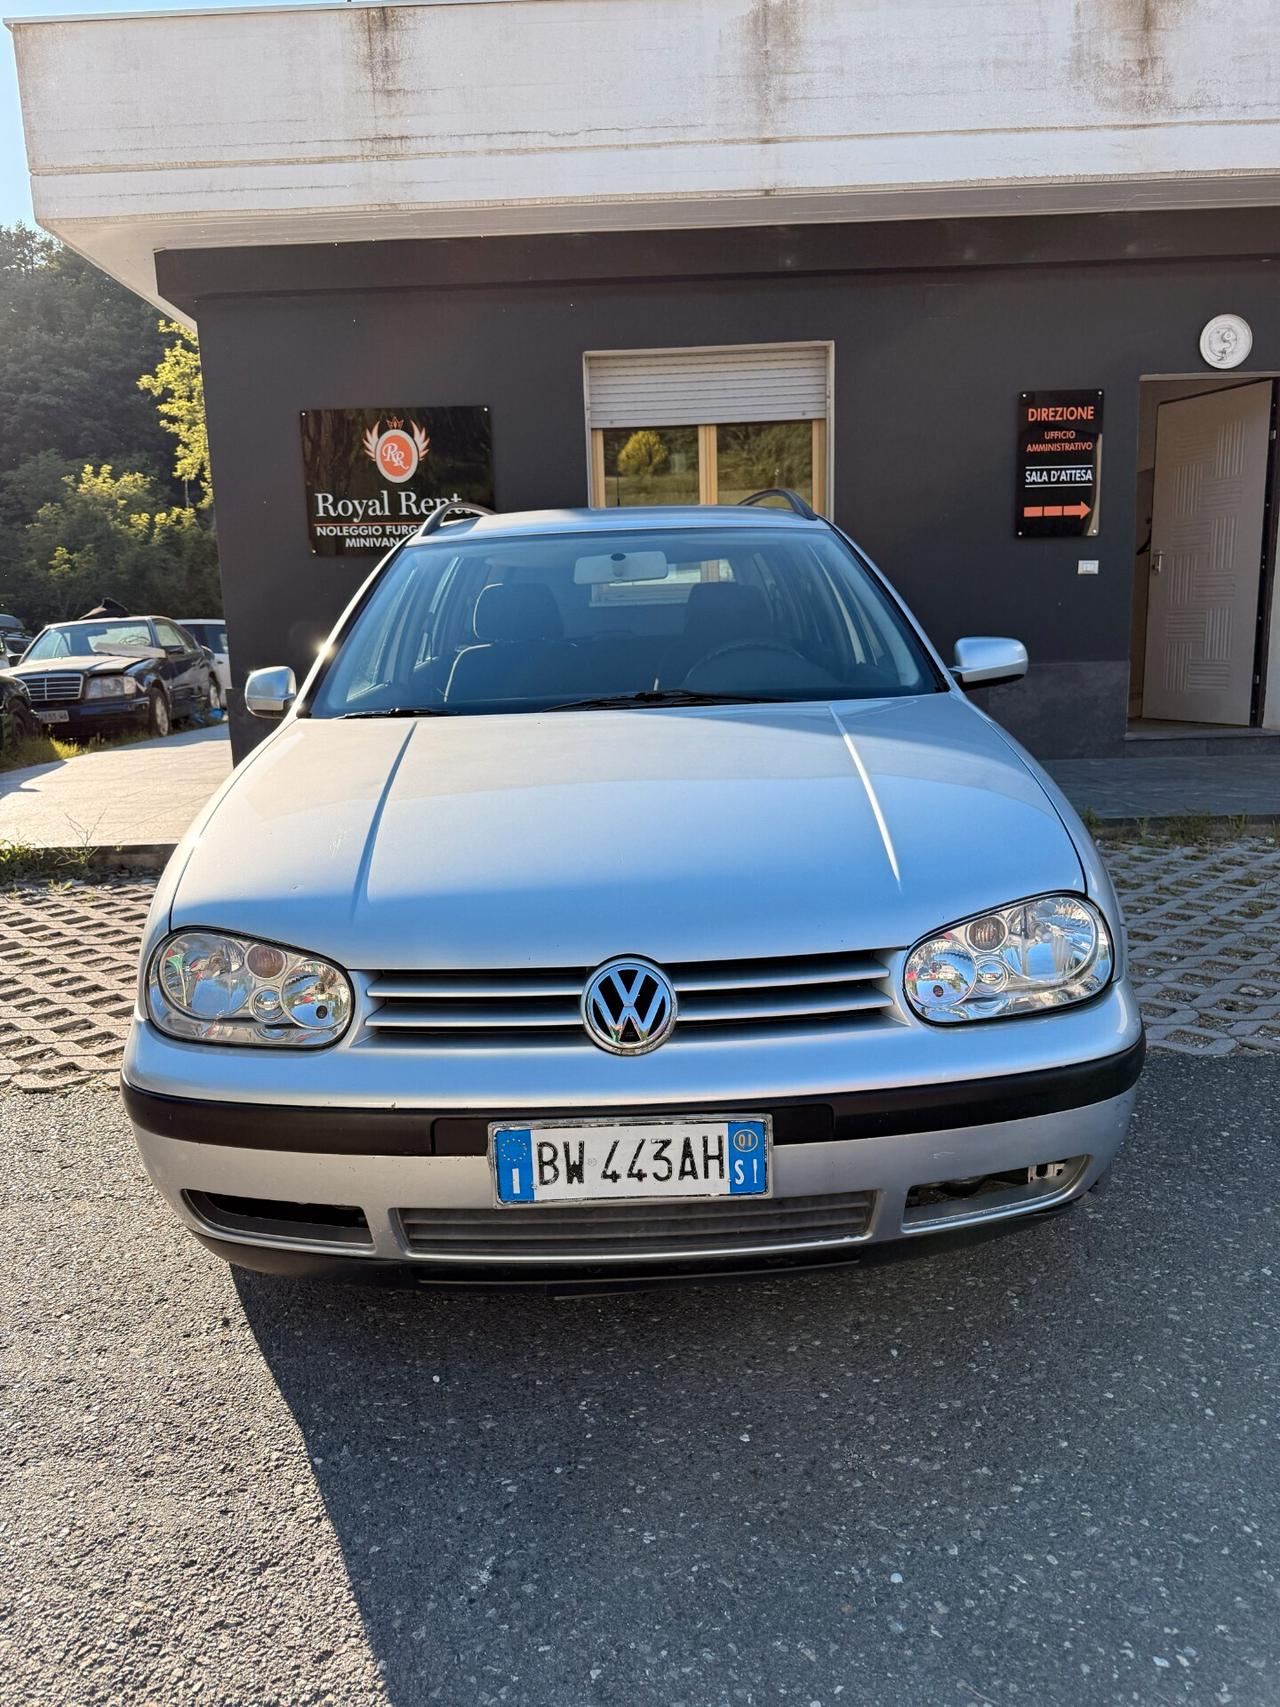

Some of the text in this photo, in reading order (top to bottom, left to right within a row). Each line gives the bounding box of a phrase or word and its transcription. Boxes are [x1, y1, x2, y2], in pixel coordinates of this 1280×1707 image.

[1028, 406, 1095, 421] DIREZIONE
[1044, 430, 1076, 440] UFFICIO
[1026, 441, 1093, 453] AMMINISTRATIVO
[1025, 469, 1093, 483] SALA D'ATTESA
[314, 490, 391, 522] Royal
[316, 525, 423, 536] NOLEGGIO FURG
[345, 537, 399, 548] MINIVAN
[588, 964, 670, 1046] VW
[536, 1135, 725, 1186] BW 443AH
[511, 1167, 521, 1194] I
